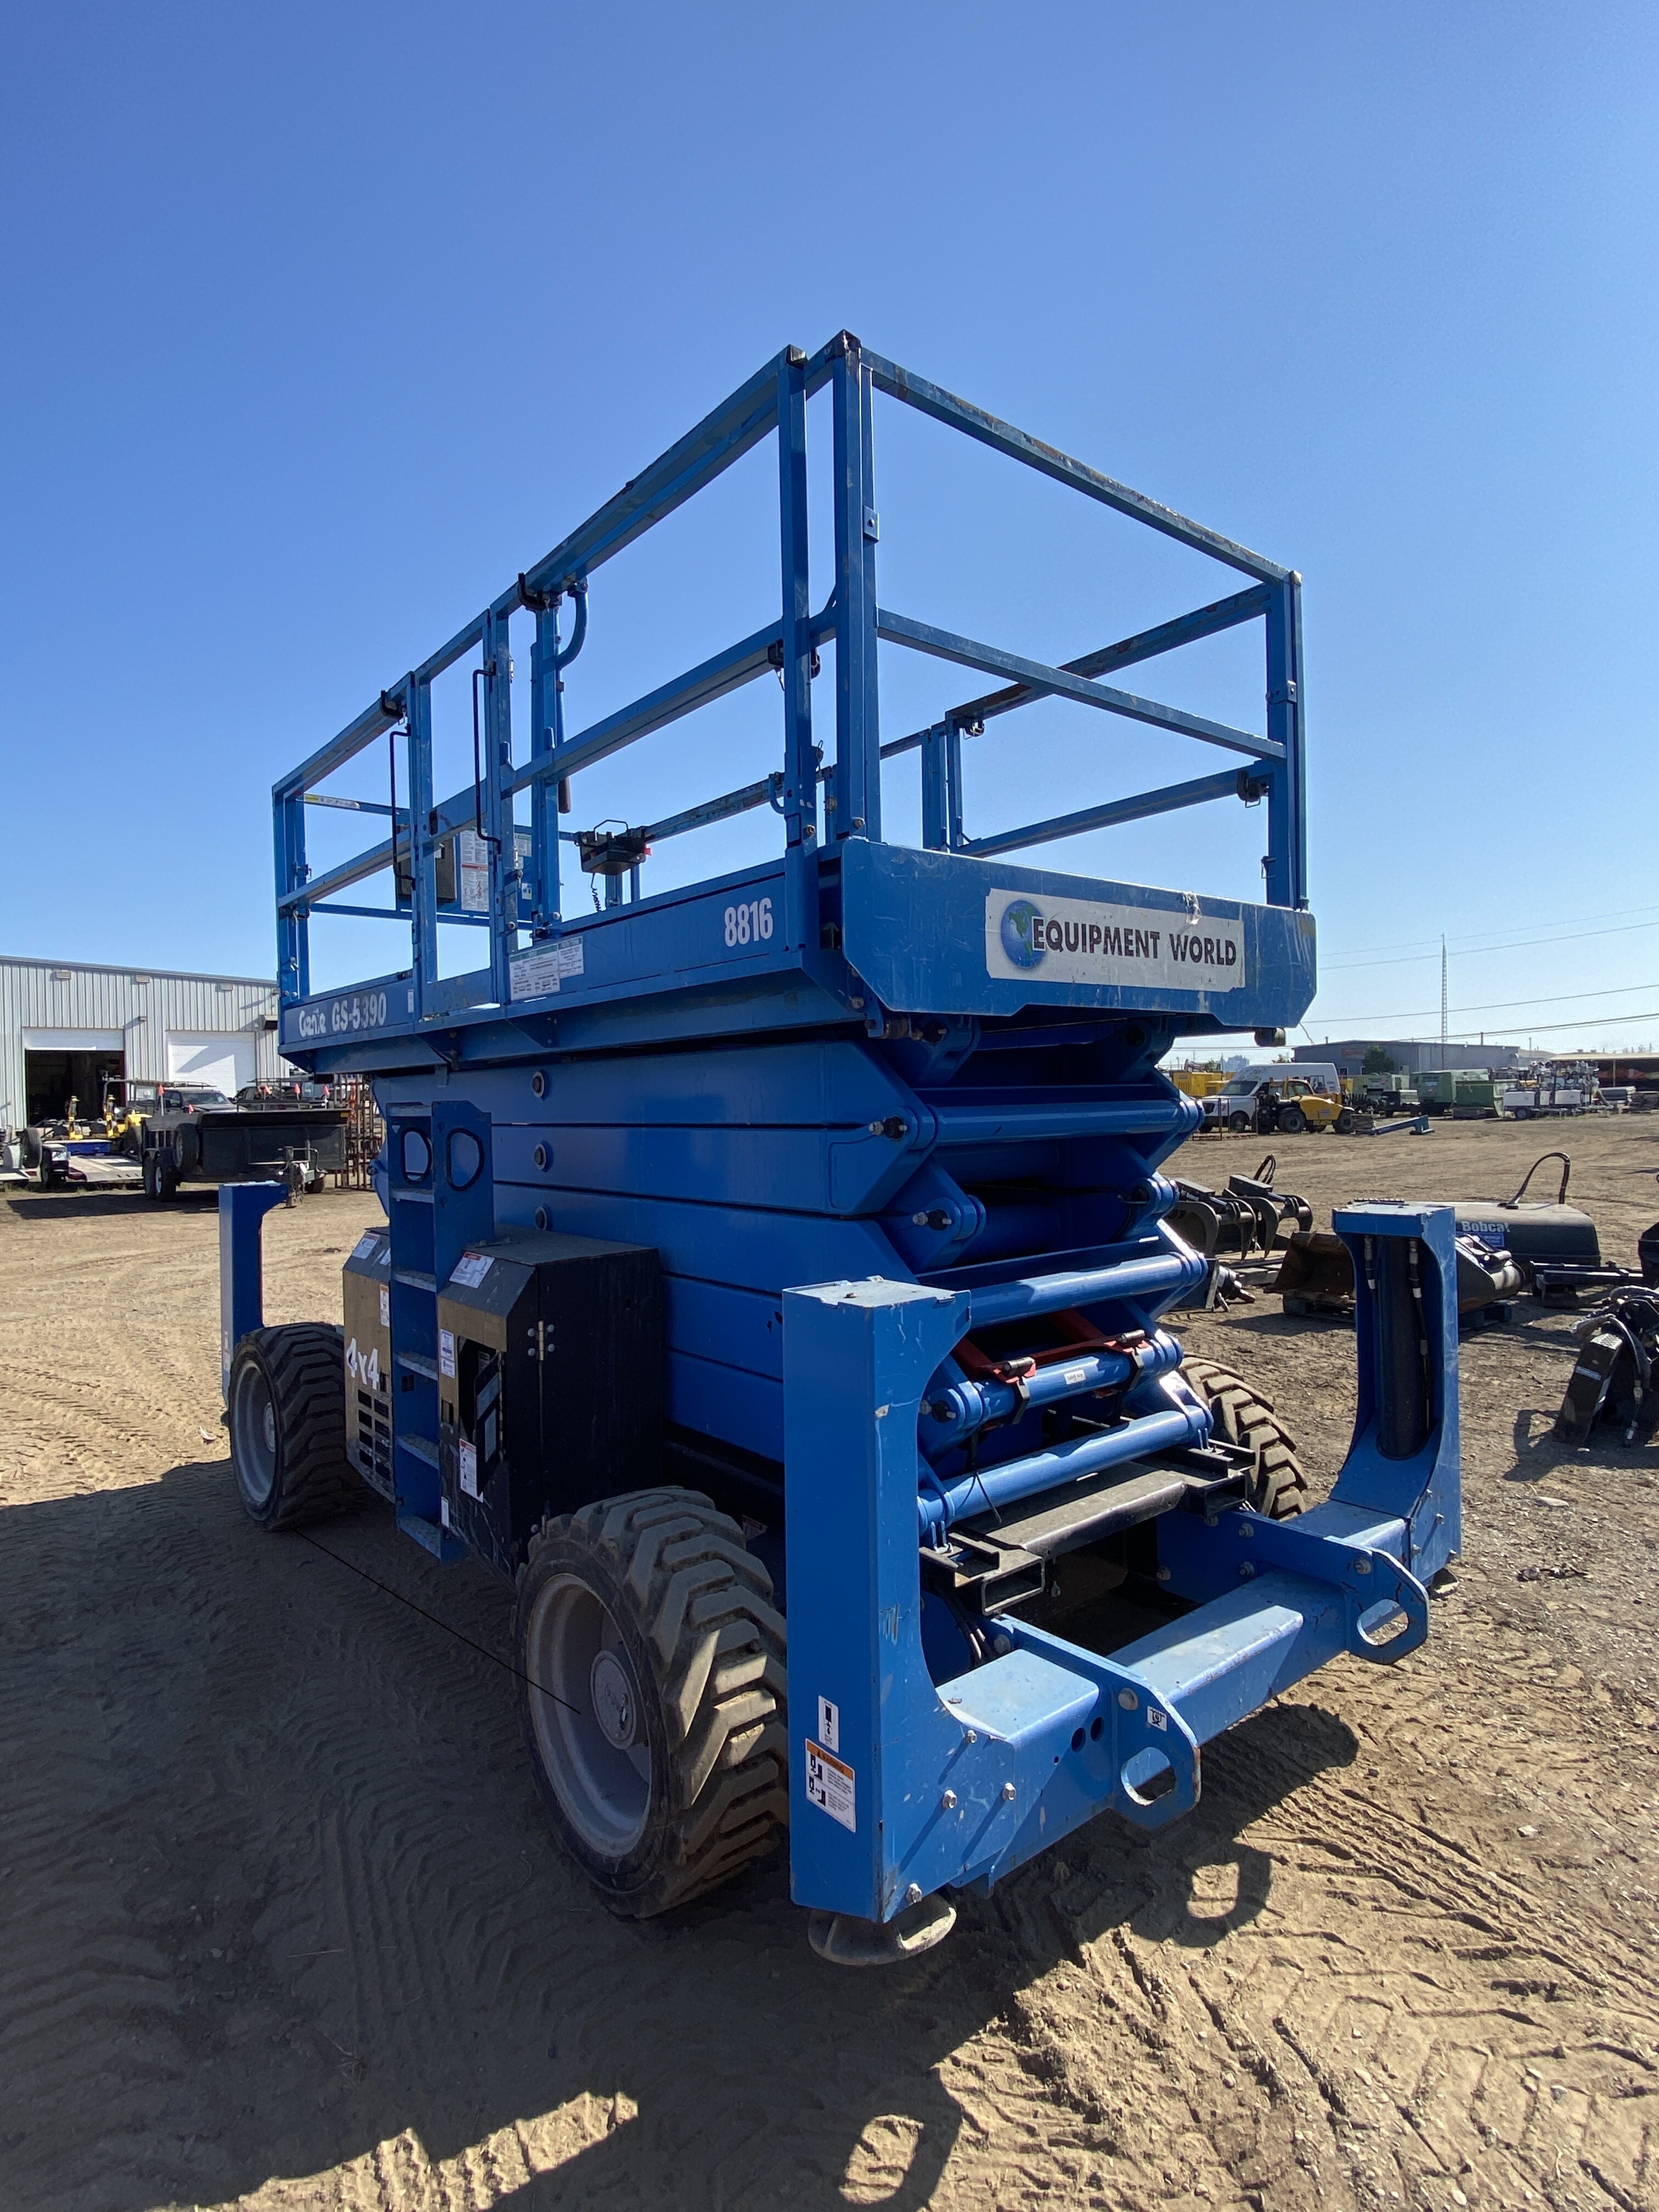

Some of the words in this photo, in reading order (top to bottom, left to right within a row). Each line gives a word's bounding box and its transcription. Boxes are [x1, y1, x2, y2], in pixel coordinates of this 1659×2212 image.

[725, 898, 773, 947] 8816
[1034, 918, 1160, 959] EQUIPMENT
[1170, 933, 1237, 966] WORLD
[1461, 1221, 1510, 1233] Bobcat
